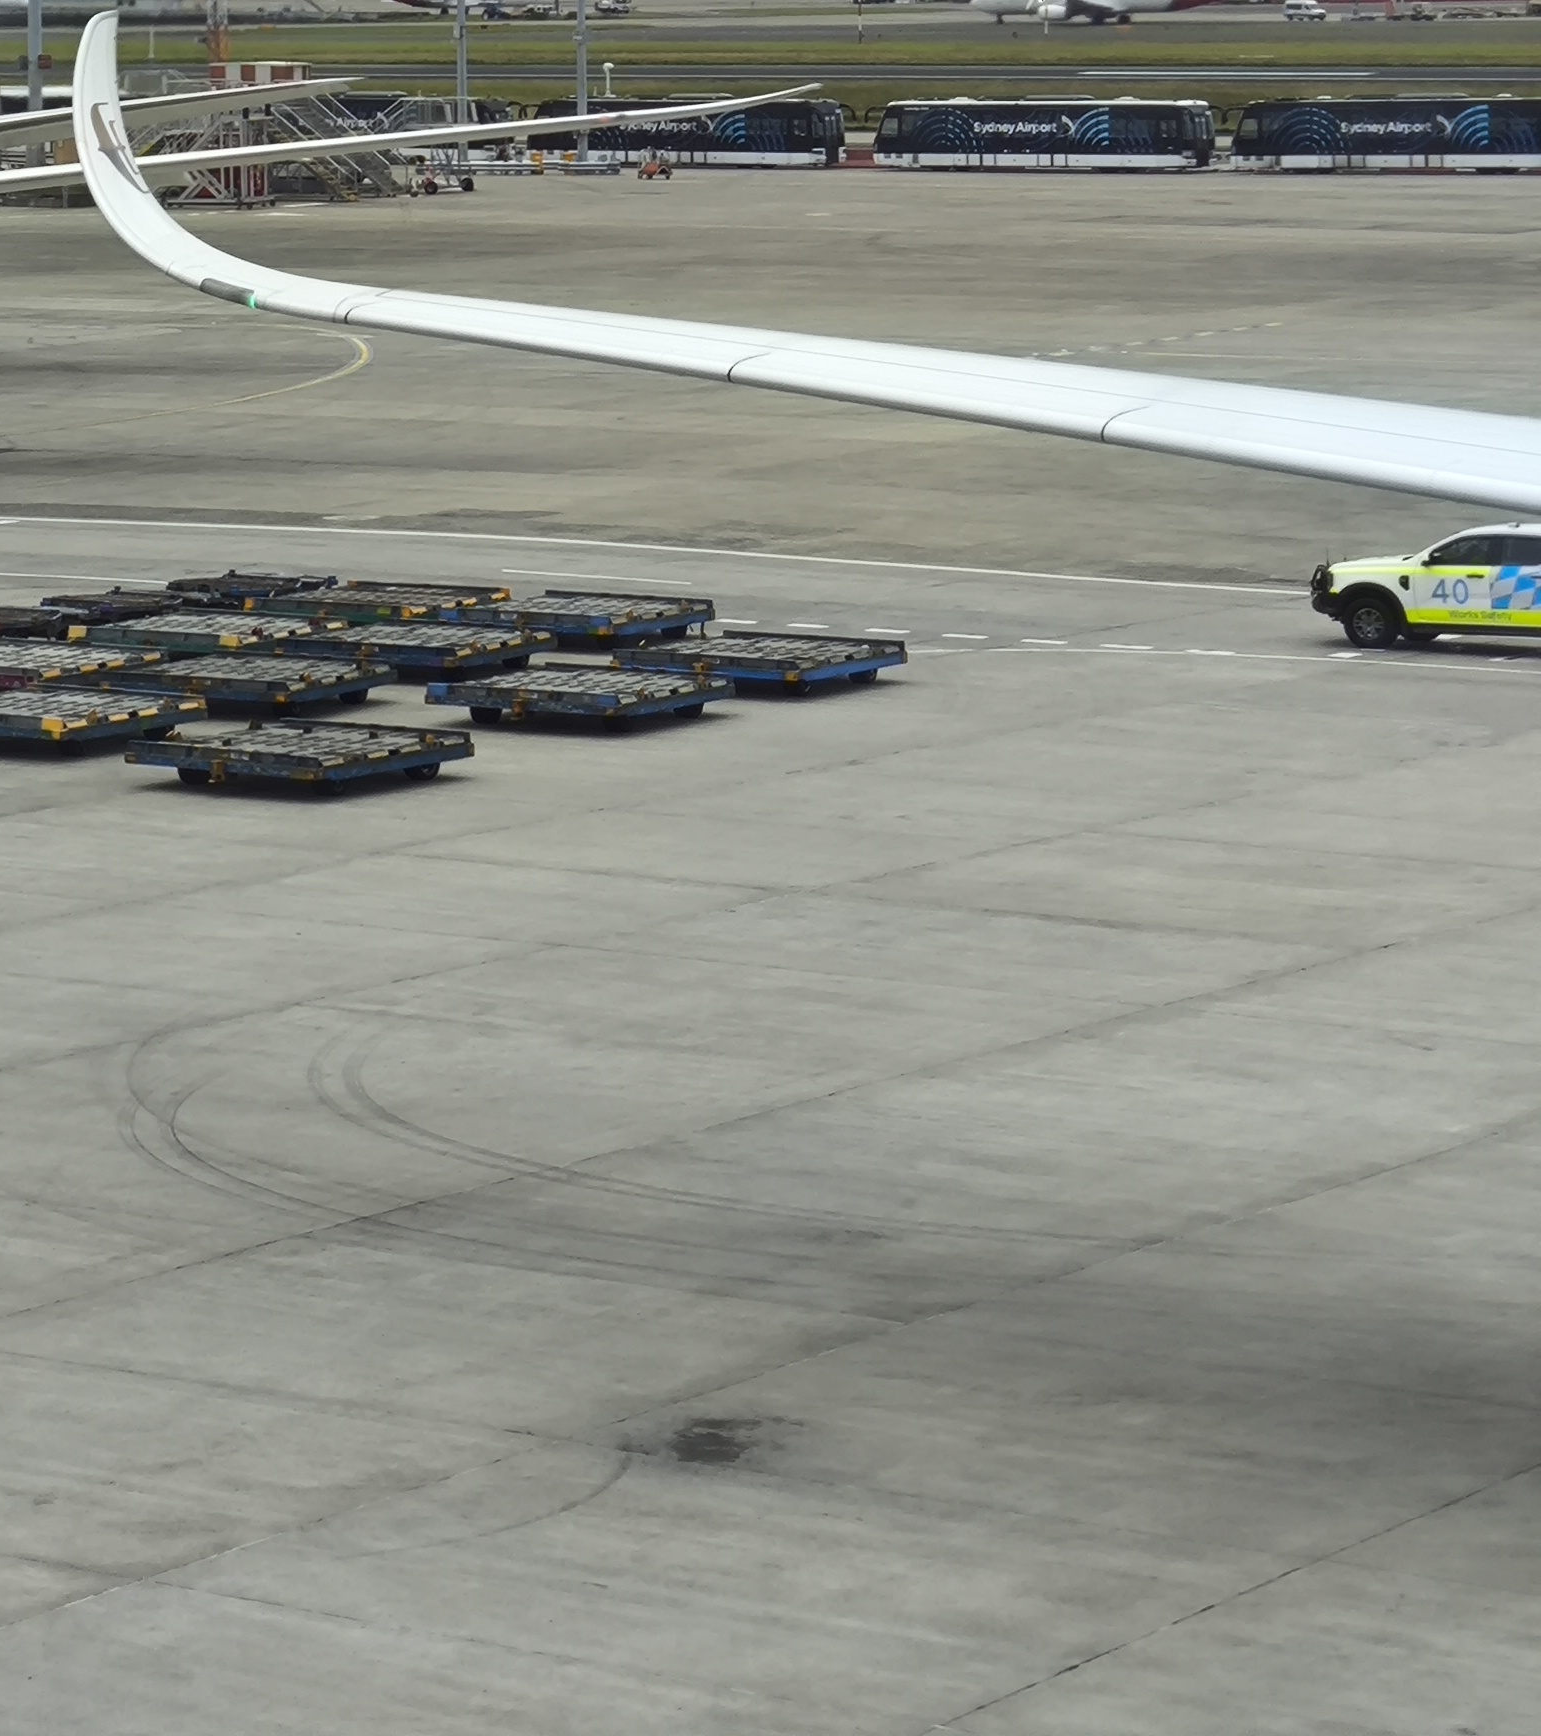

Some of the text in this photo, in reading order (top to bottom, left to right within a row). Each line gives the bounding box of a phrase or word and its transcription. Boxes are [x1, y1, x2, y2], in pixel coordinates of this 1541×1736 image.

[659, 120, 697, 132] Airport
[973, 121, 1057, 135] Sydney Airport
[1340, 121, 1432, 134] Sydney Airport
[1432, 578, 1469, 604] 40
